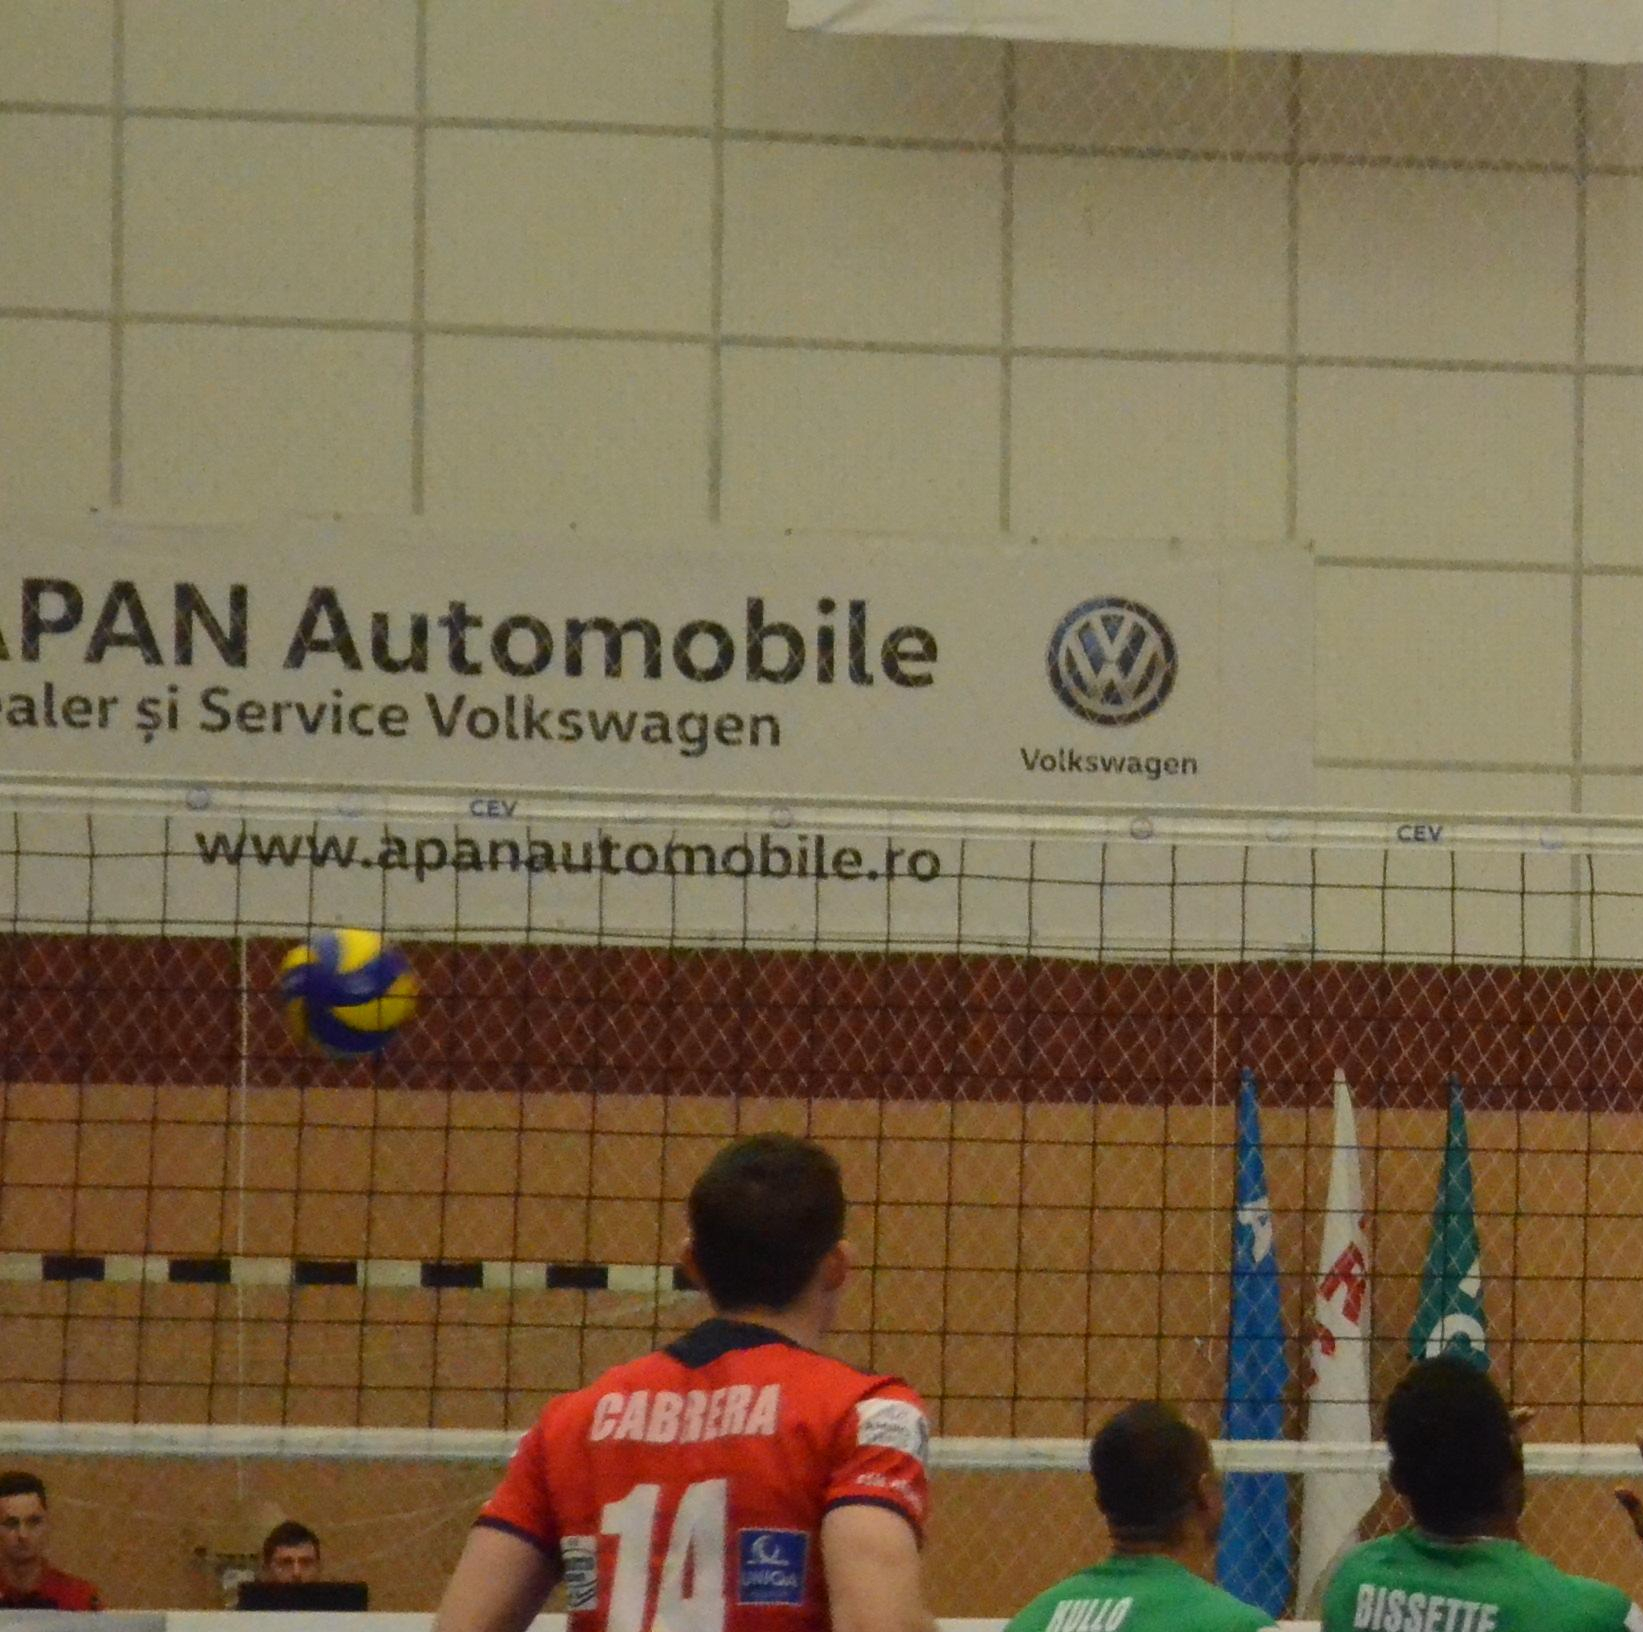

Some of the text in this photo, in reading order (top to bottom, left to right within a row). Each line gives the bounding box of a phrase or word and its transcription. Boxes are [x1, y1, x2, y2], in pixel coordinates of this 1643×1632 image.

[0, 576, 938, 688] PAN Automobile
[4, 682, 119, 729] aler
[200, 685, 409, 737] Service
[425, 691, 782, 758] Volkswagen
[1020, 747, 1198, 780] Volkswagen
[469, 800, 518, 818] CEV
[1396, 824, 1443, 842] CEV
[194, 826, 943, 883] www.apanautomobile.ro
[590, 1383, 782, 1444] CABRERA
